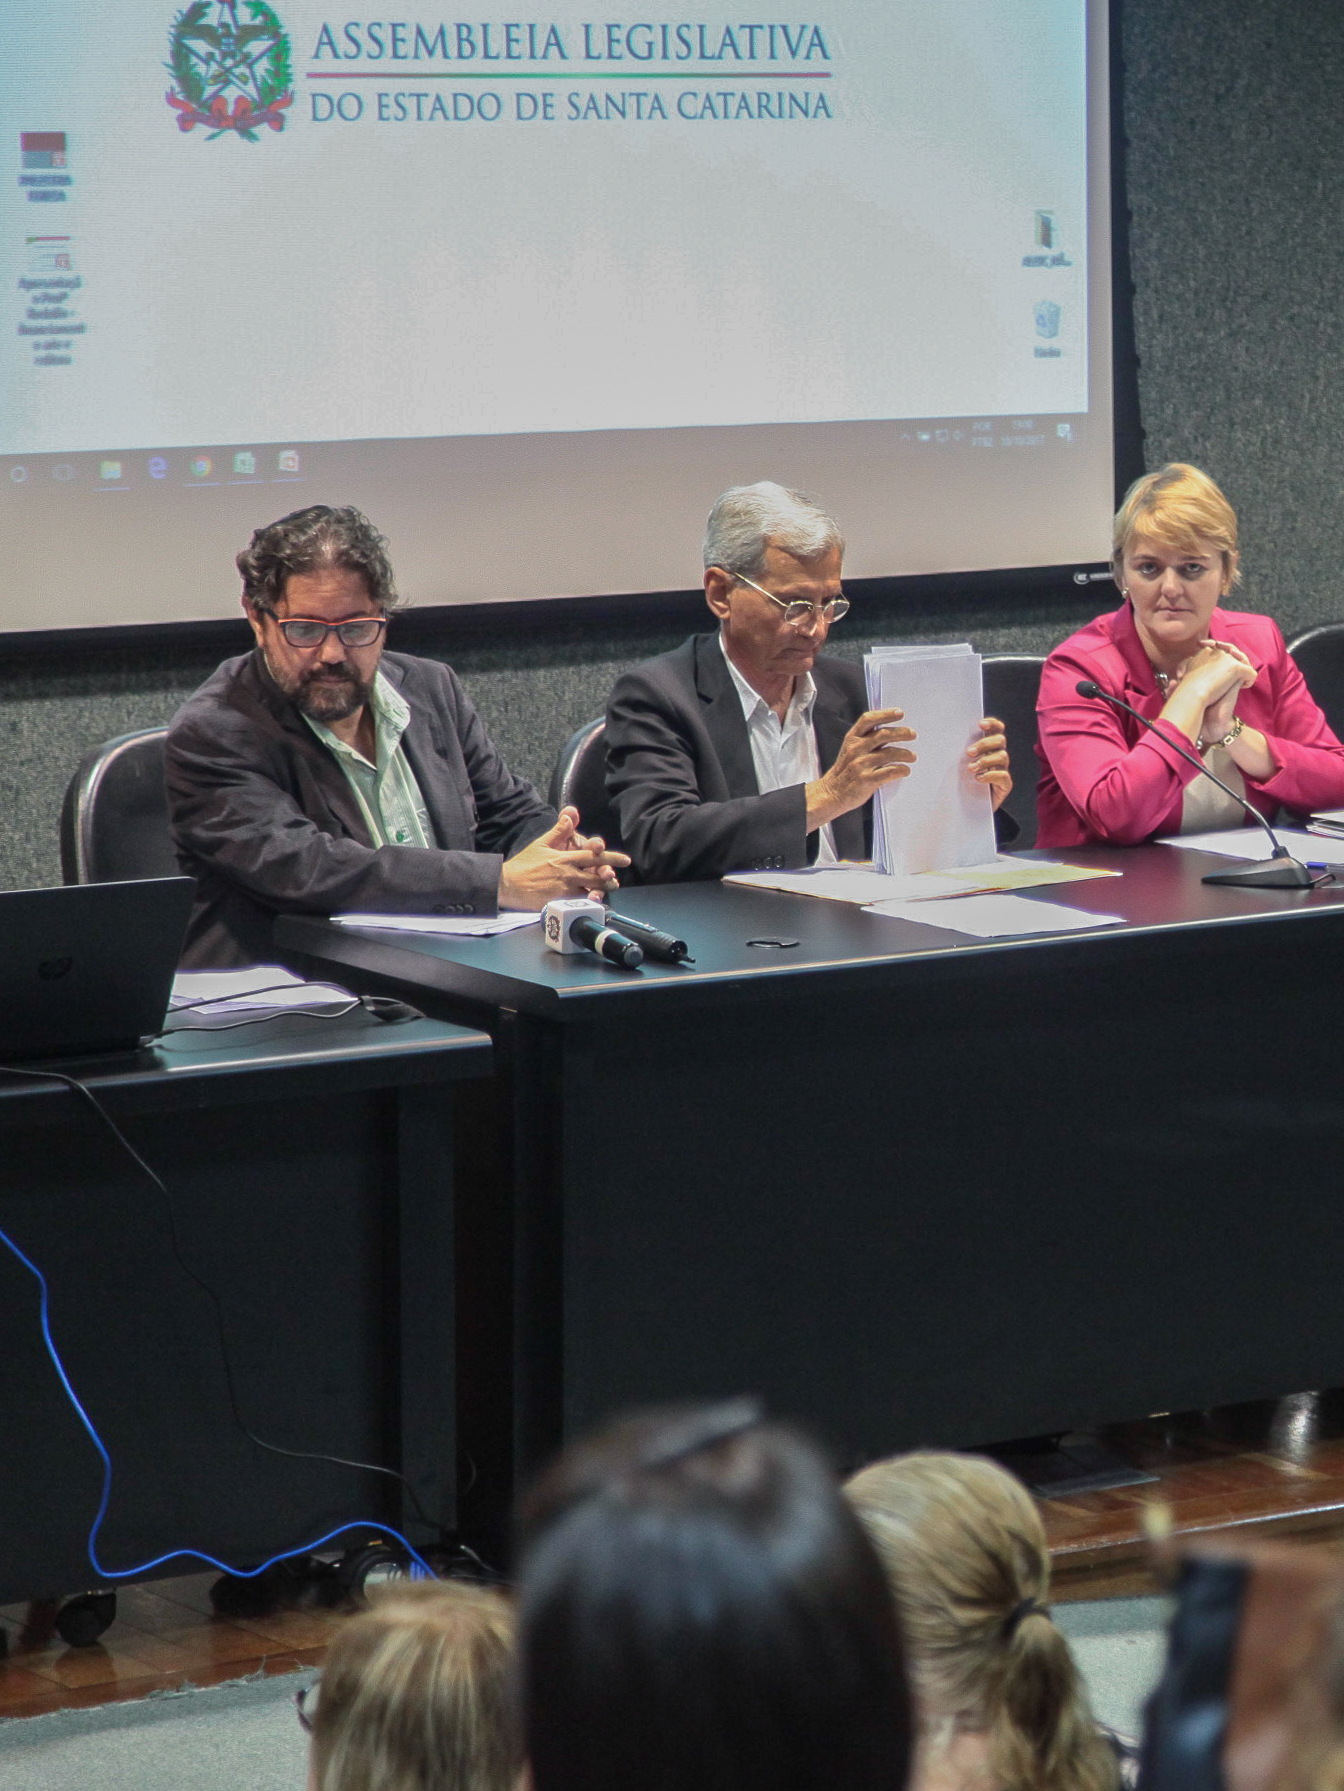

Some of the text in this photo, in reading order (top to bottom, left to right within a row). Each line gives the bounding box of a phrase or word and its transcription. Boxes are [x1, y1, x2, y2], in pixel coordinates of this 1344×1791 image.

[311, 21, 832, 61] ASSEMBLEIA LEGISLATIVA
[309, 90, 833, 121] DO ESTADO DE SANTA CATARINA
